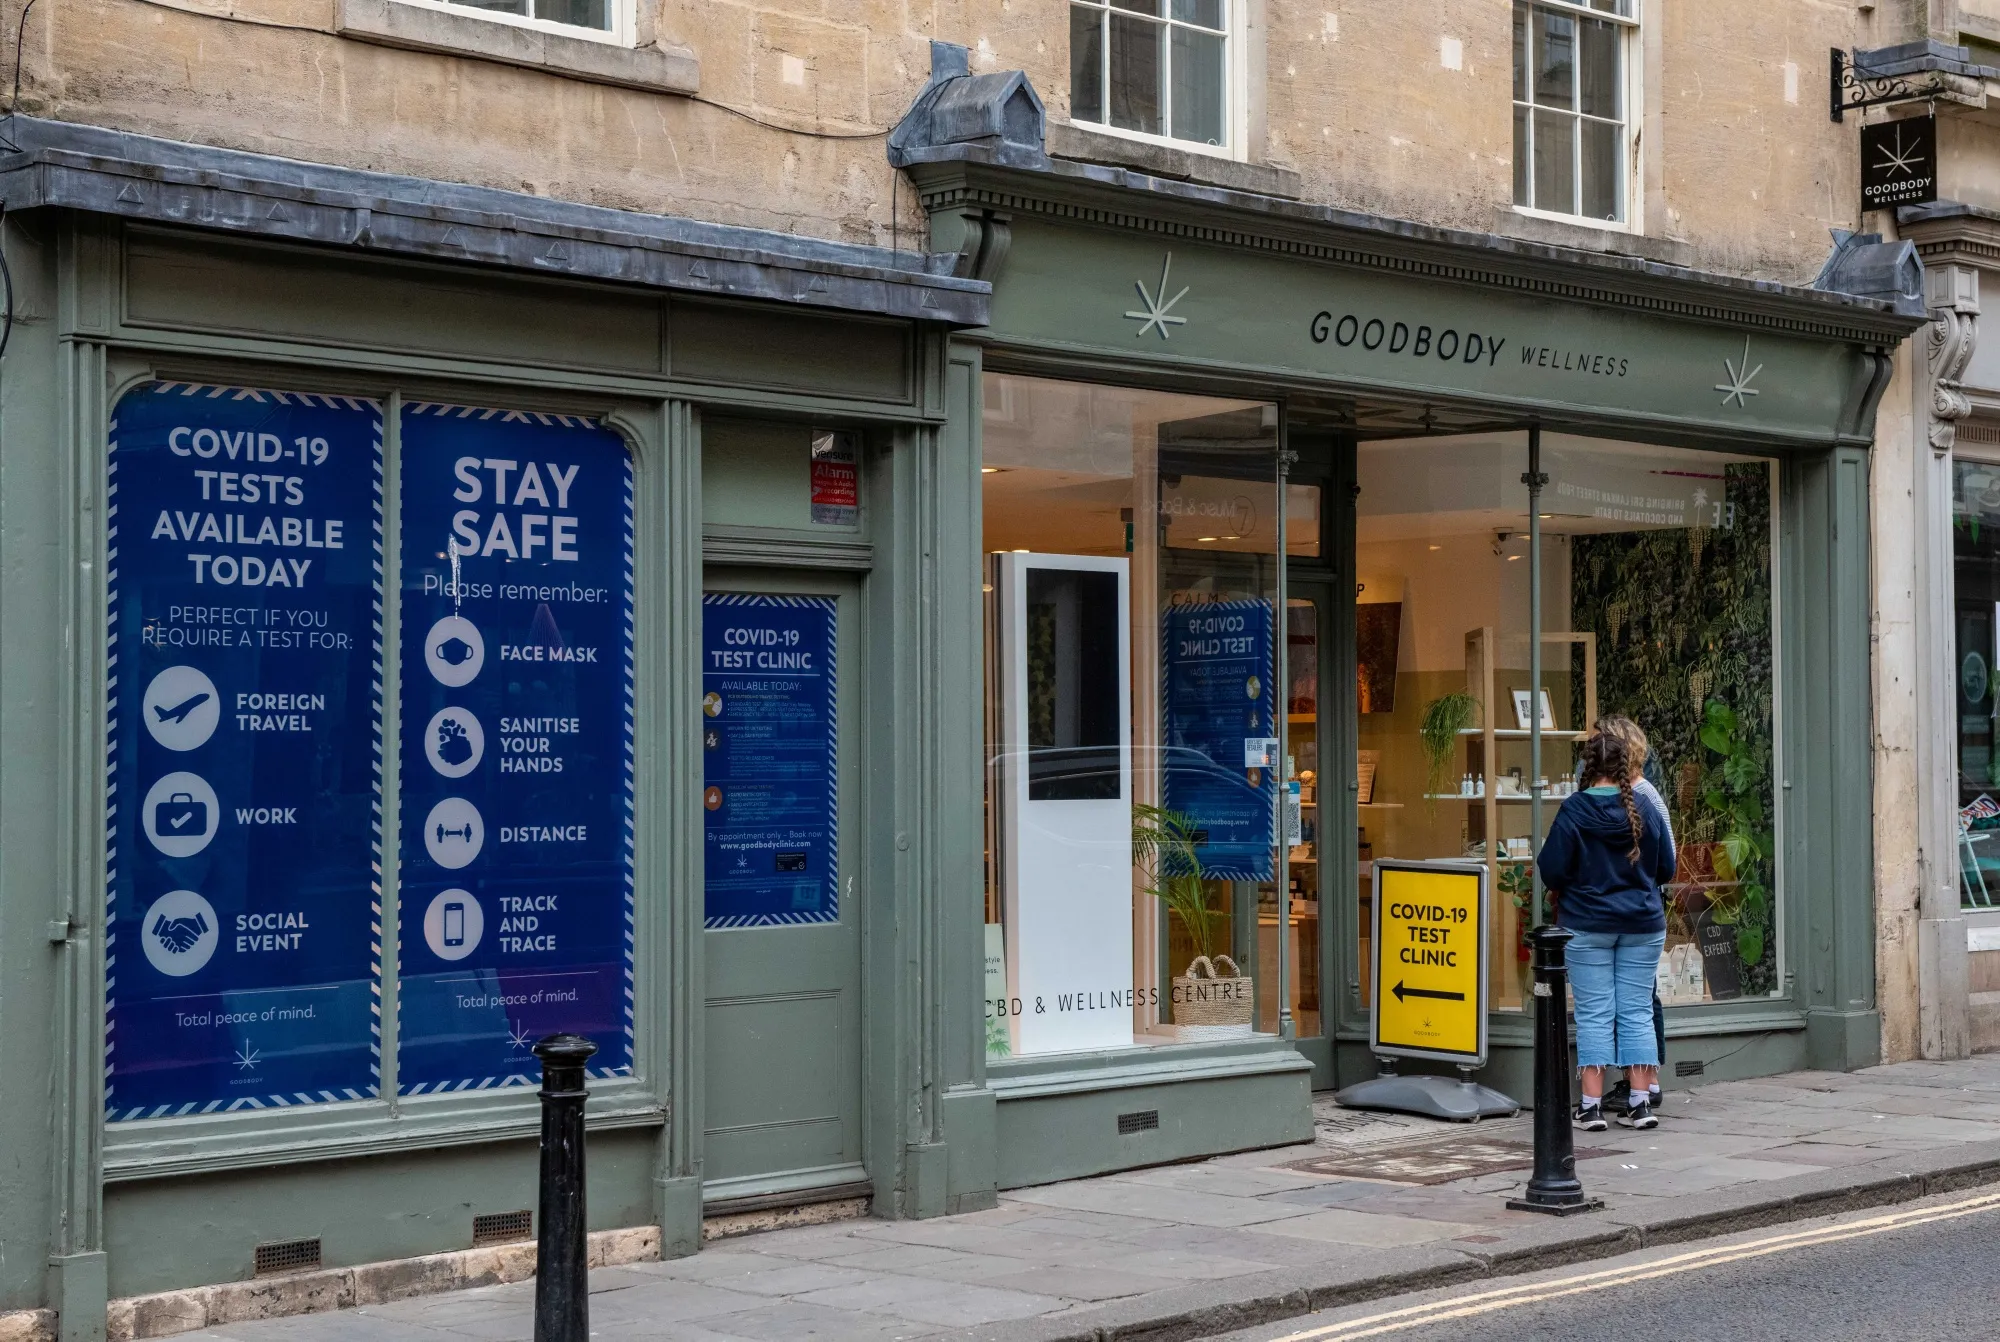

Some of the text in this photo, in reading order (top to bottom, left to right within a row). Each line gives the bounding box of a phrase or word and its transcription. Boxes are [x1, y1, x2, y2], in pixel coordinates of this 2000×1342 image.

[1865, 177, 1932, 195] GOODBODY
[1874, 190, 1923, 203] WELLNESS
[1310, 310, 1629, 377] GOODBODY WELLNESS
[168, 426, 329, 466] COVID-19
[815, 449, 853, 460] verisure
[815, 463, 854, 480] Alarm
[194, 469, 304, 506] TESTS
[453, 456, 580, 508] STAY
[151, 510, 344, 549] AVAILABLE
[452, 510, 579, 561] SAFE
[188, 554, 312, 588] TODAY
[424, 574, 608, 603] Please remember:
[169, 605, 329, 627] PERFECT IF YOU
[142, 627, 353, 650] REQUIRE A TEST FOR:
[724, 628, 800, 646] COVID-19
[500, 645, 598, 662] FACE MASK
[711, 651, 812, 669] TEST CLINIC
[721, 681, 768, 691] AVAILABLE
[236, 694, 325, 711] FOREIGN
[236, 715, 312, 731] TRAVEL
[500, 717, 580, 733] SANITISE
[500, 737, 550, 753] YOUR
[500, 757, 563, 773] HANDS
[236, 807, 297, 824] WORK
[500, 826, 587, 843] DISTANCE
[708, 832, 717, 842] By
[719, 832, 765, 842] appointment
[767, 831, 782, 840] only
[720, 840, 811, 851] www.goodbodyclinic.com
[499, 895, 558, 912] TRACK
[236, 912, 309, 931] SOCIAL
[1390, 903, 1468, 923] COVID-19
[499, 916, 539, 933] AND
[1707, 925, 1721, 938] CBD
[236, 933, 302, 952] EVENT
[499, 935, 556, 953] TRACE
[1408, 926, 1450, 944] TEST
[1400, 948, 1457, 967] CLINIC
[1703, 941, 1732, 957] EXPERTS
[456, 988, 579, 1009] Total peace of mind.
[1035, 996, 1046, 1014] &
[1058, 987, 1159, 1012] WELLNESS
[1172, 981, 1243, 1004] CENTRE
[175, 1005, 316, 1028] Total peace of mind.
